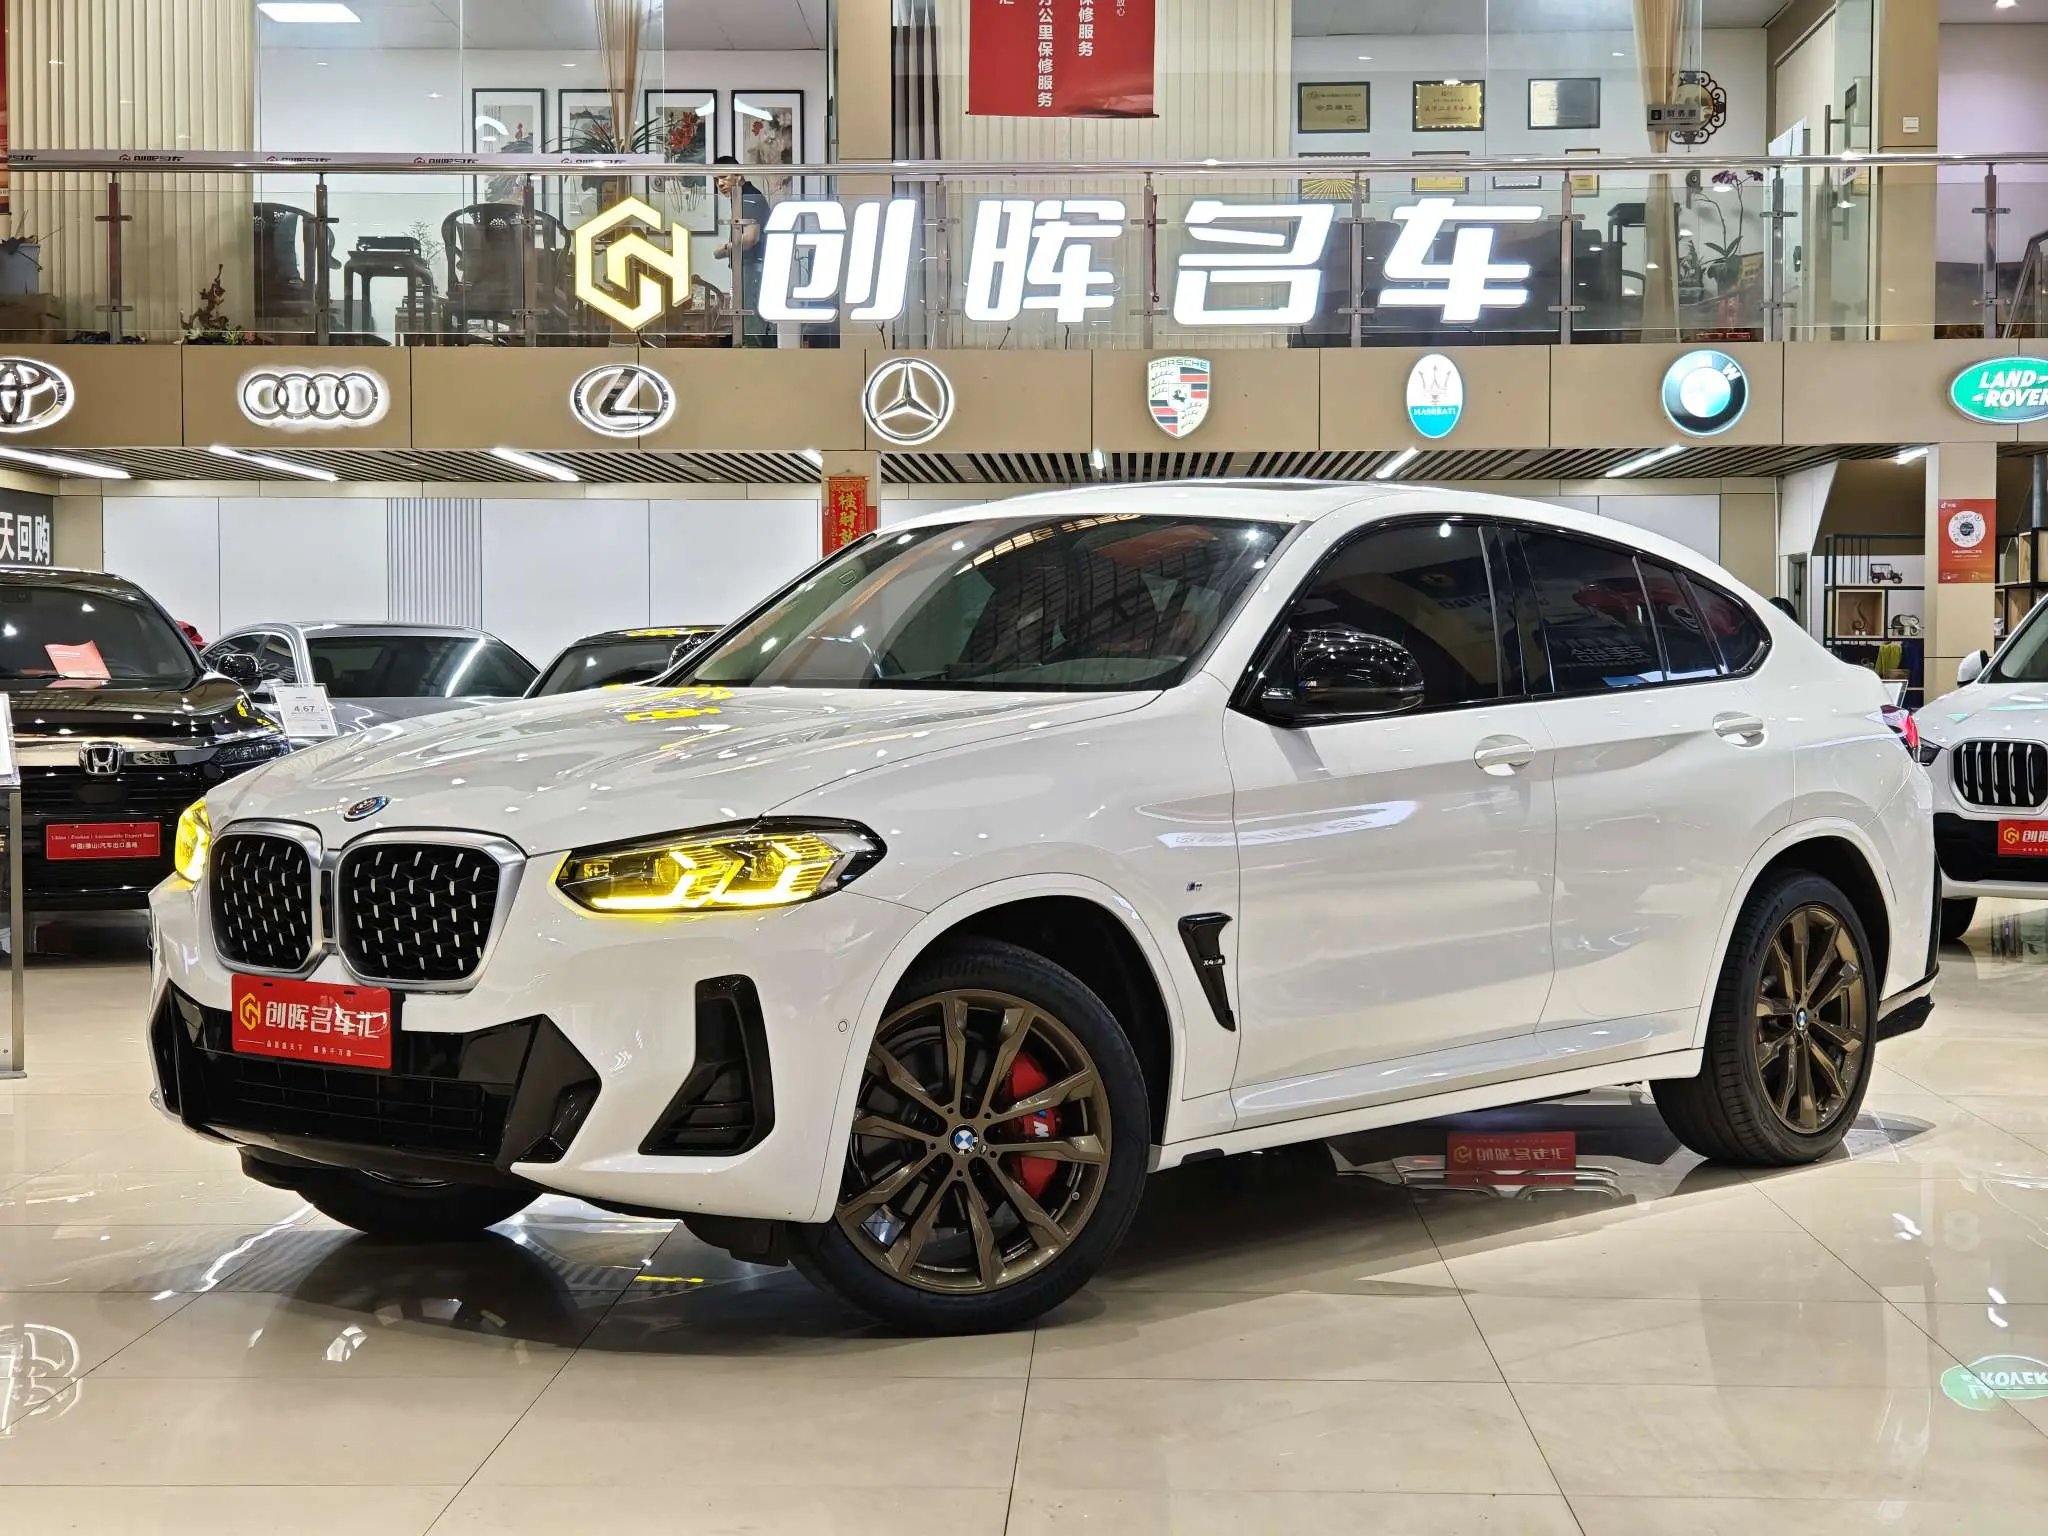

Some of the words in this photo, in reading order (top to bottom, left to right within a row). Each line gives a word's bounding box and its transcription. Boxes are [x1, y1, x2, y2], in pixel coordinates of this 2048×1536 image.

[757, 198, 1543, 325] 创晖名车
[1150, 359, 1208, 369] PORSCHE
[1978, 369, 2037, 389] LAND
[265, 1001, 388, 1039] 创晖名车汇
